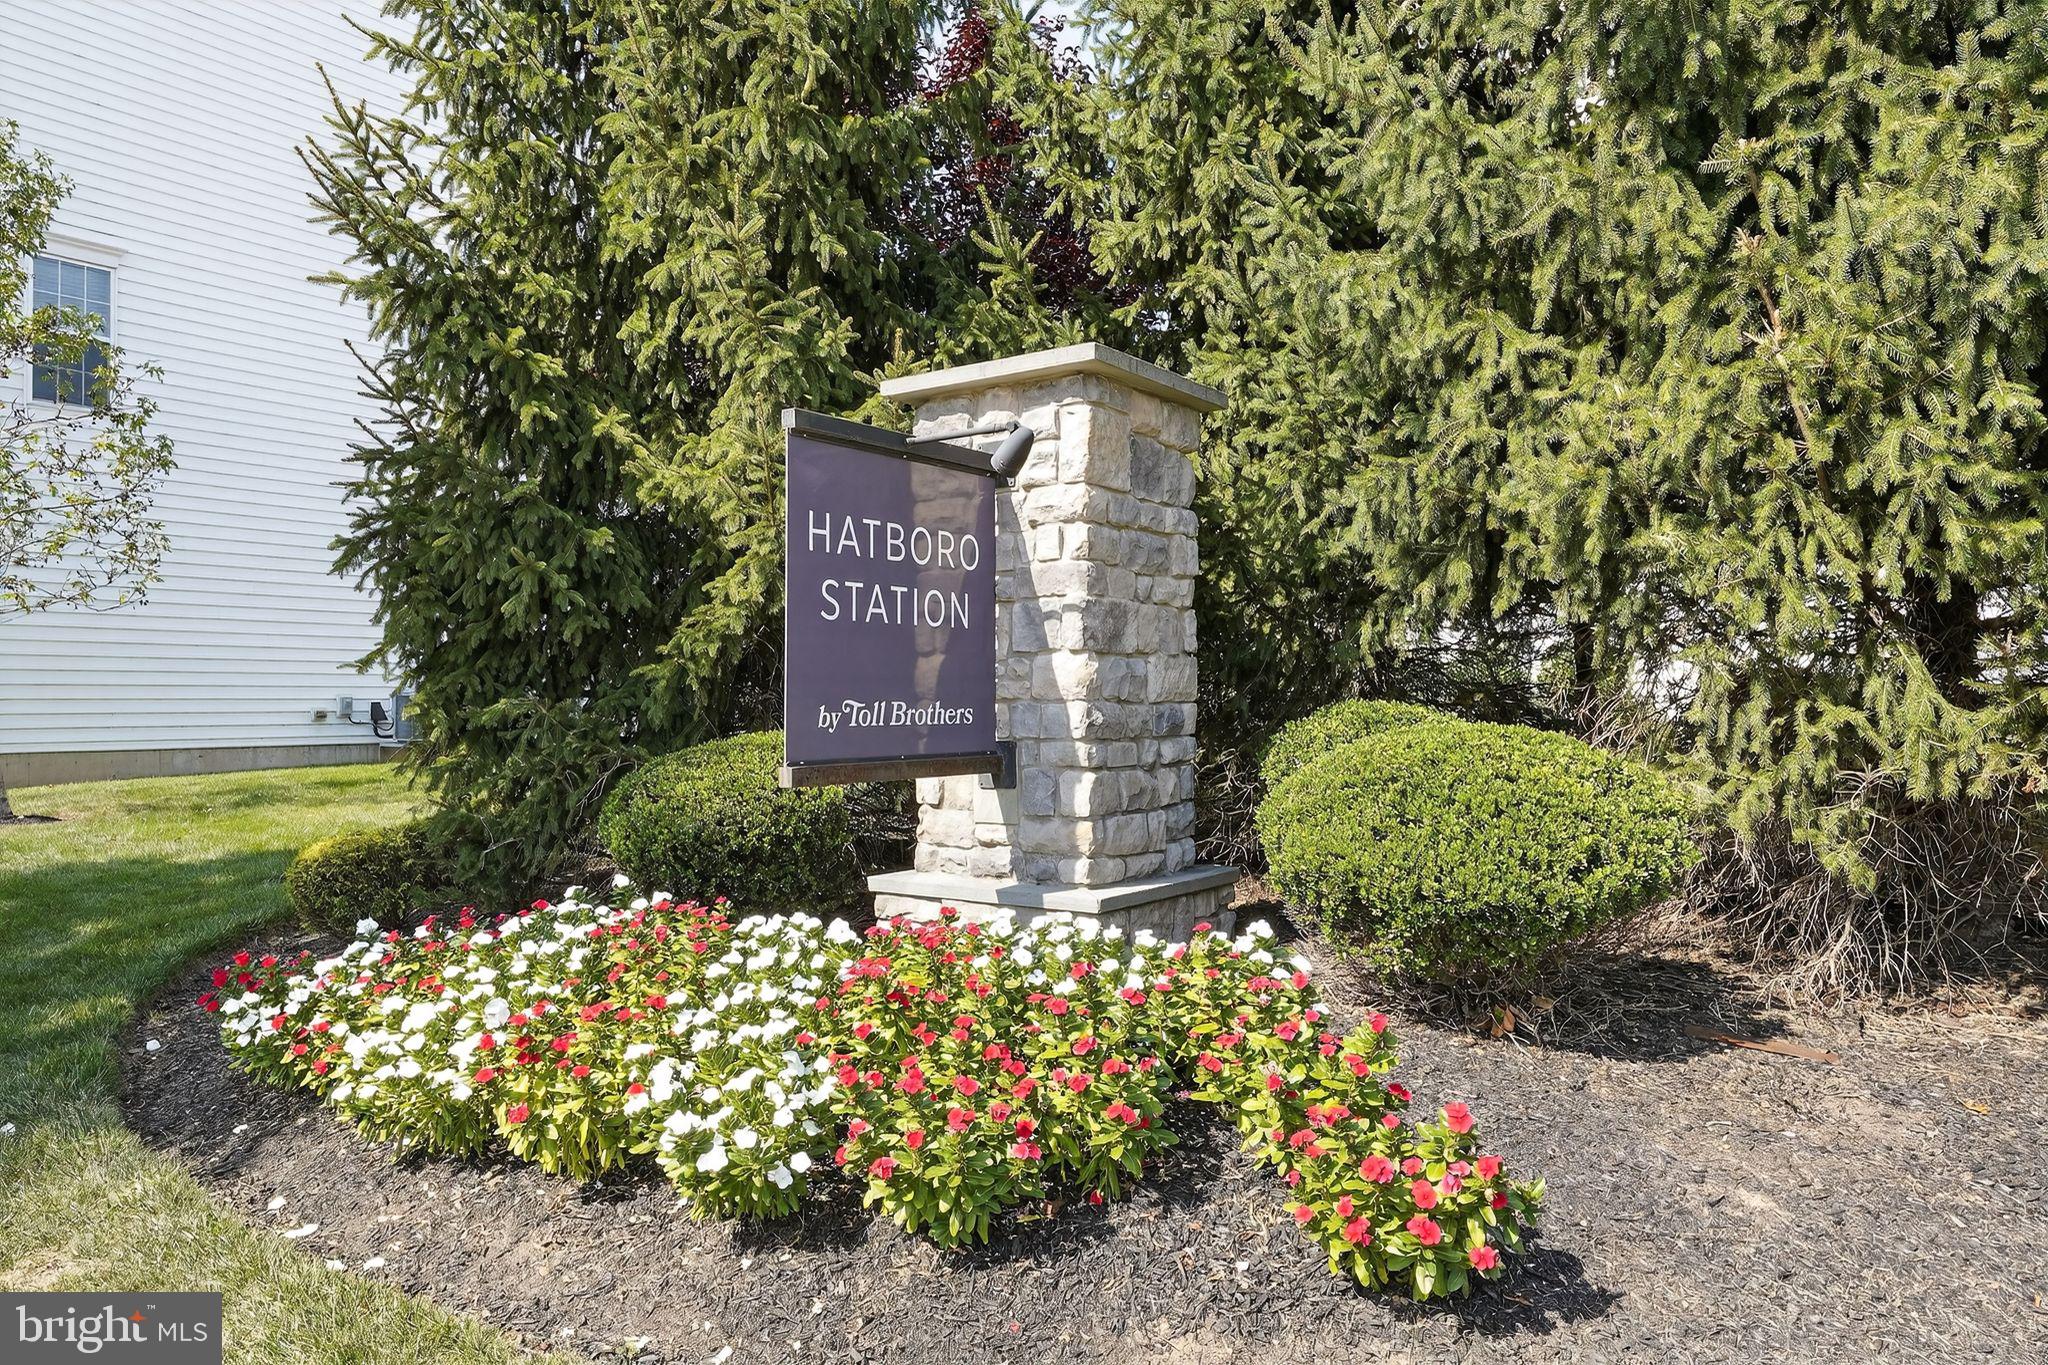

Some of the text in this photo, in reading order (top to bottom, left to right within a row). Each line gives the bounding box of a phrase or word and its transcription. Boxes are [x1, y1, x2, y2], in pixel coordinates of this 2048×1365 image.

[808, 509, 980, 571] HATBORO
[820, 578, 969, 629] STATION
[817, 699, 974, 733] by Toll Brothers
